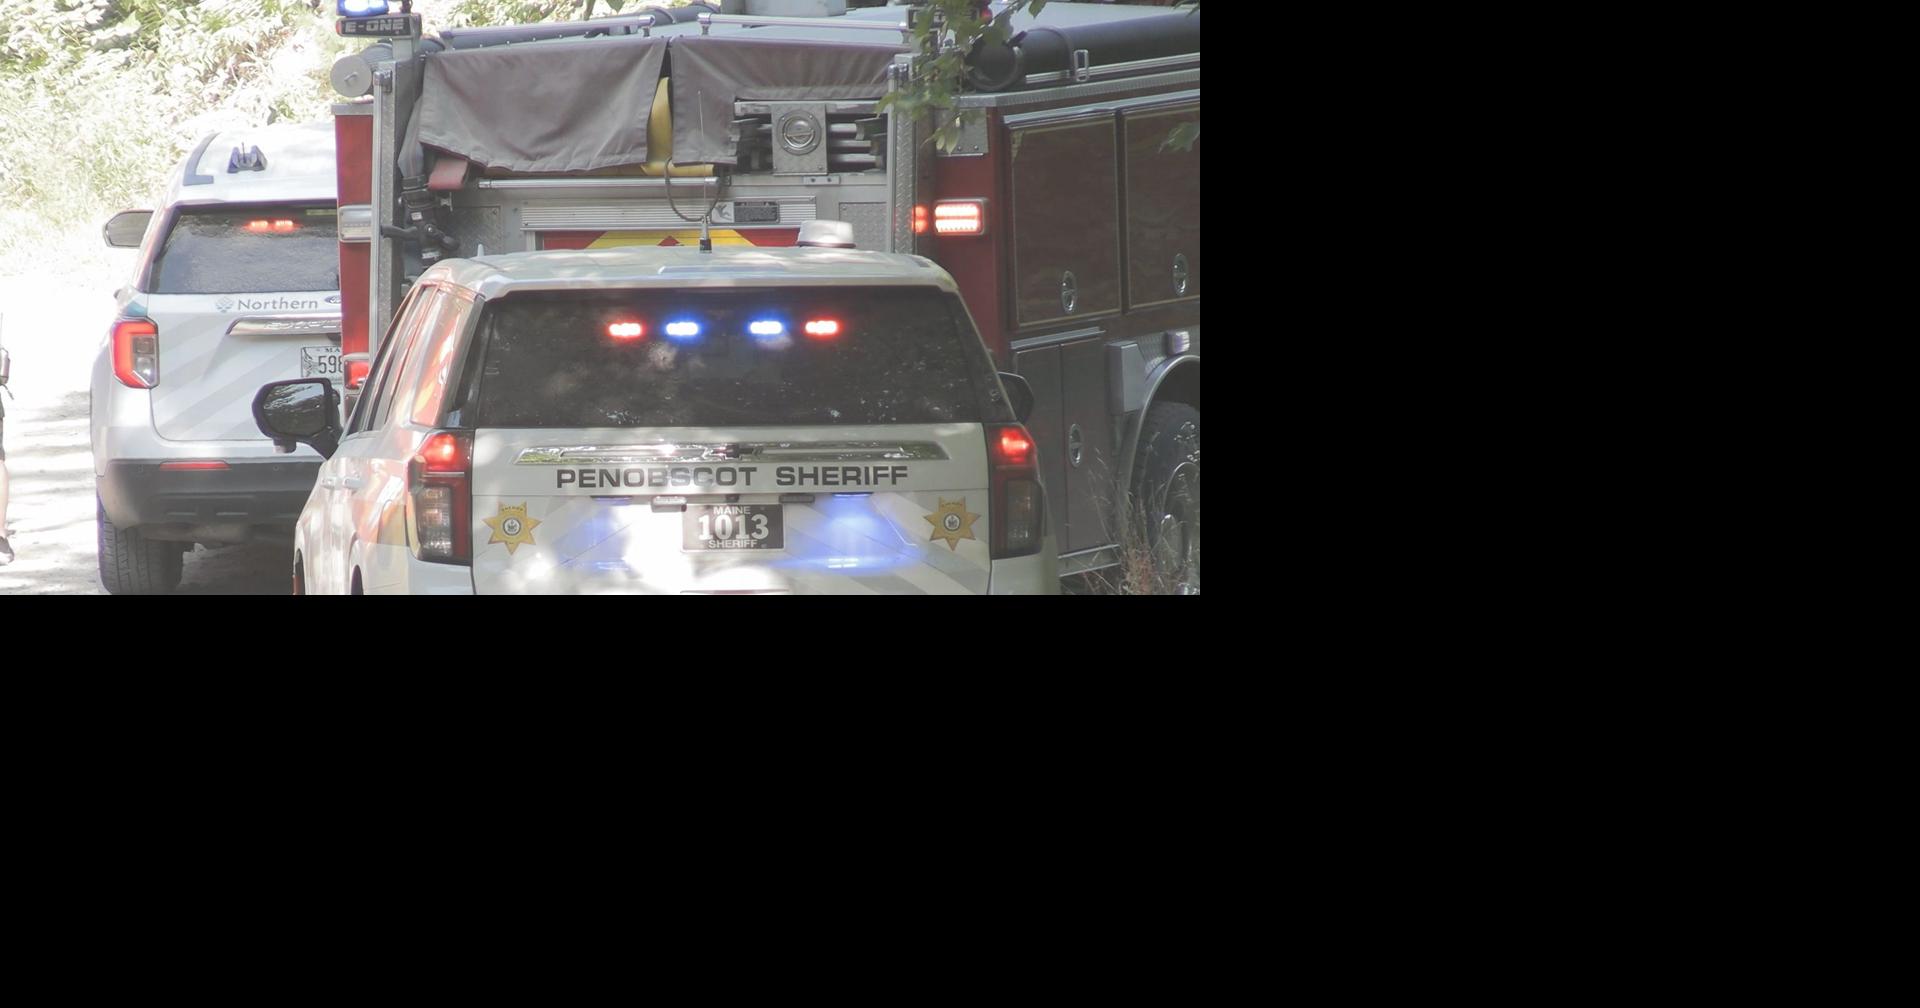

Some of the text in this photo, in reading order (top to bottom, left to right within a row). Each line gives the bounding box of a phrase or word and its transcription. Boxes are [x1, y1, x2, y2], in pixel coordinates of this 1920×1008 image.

[345, 19, 404, 32] E-ONE
[238, 297, 318, 310] Northern
[556, 466, 908, 488] PENOBSCOT SHERIFF
[713, 506, 751, 514] MAINE
[699, 514, 769, 540] 1013
[708, 540, 758, 549] SHERIFF
